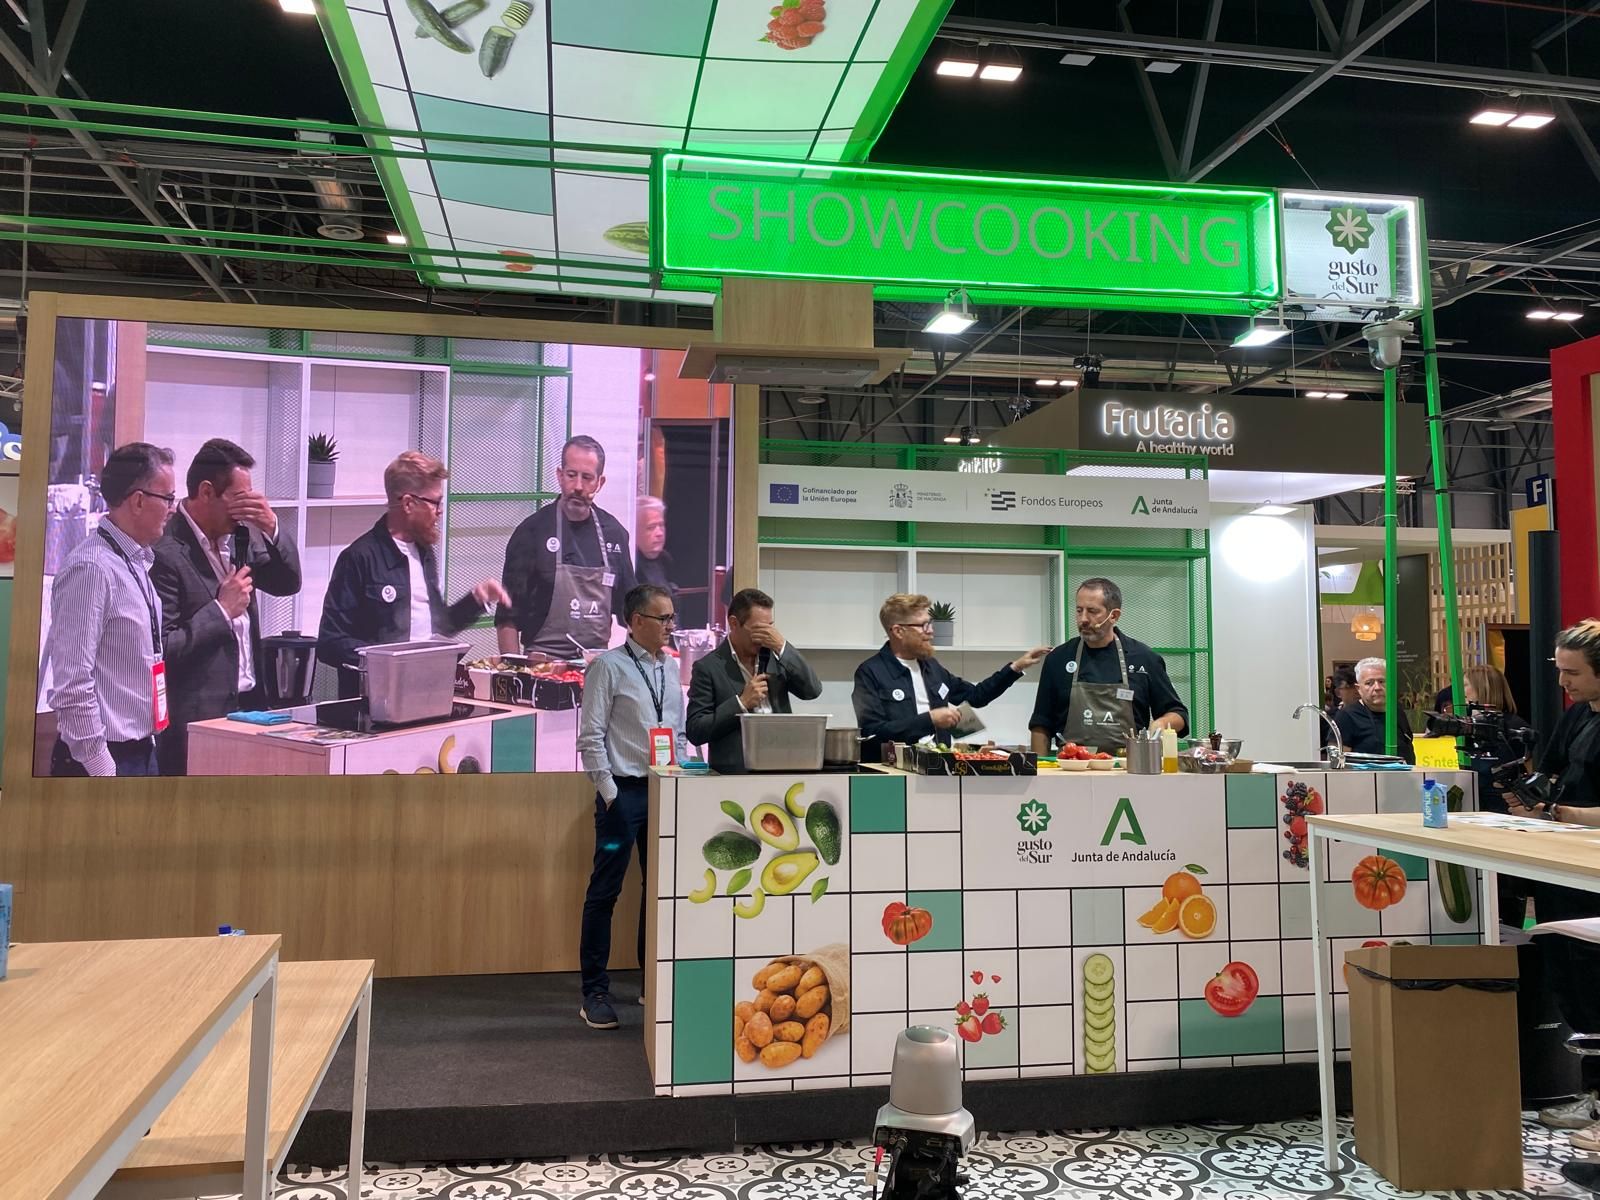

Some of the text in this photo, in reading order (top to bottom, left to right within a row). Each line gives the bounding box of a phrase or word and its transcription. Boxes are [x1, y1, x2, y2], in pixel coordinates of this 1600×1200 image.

[708, 185, 1241, 268] SHOWCOOKING
[1328, 259, 1378, 281] gusto
[1332, 276, 1378, 295] del Sur
[1103, 401, 1235, 440] Frutaria
[1136, 441, 1234, 456] A healthy world
[802, 487, 858, 497] Cofinanciado por
[1532, 479, 1543, 502] F
[810, 495, 830, 503] Unión
[830, 496, 857, 504] Europea
[1021, 496, 1103, 508] Fondos Europeos
[1152, 498, 1173, 506] Junta
[1152, 505, 1198, 515] de Andalucía
[1016, 838, 1052, 855] gusto
[1028, 851, 1053, 864] Sur
[1072, 848, 1176, 863] Junta de Andalucía
